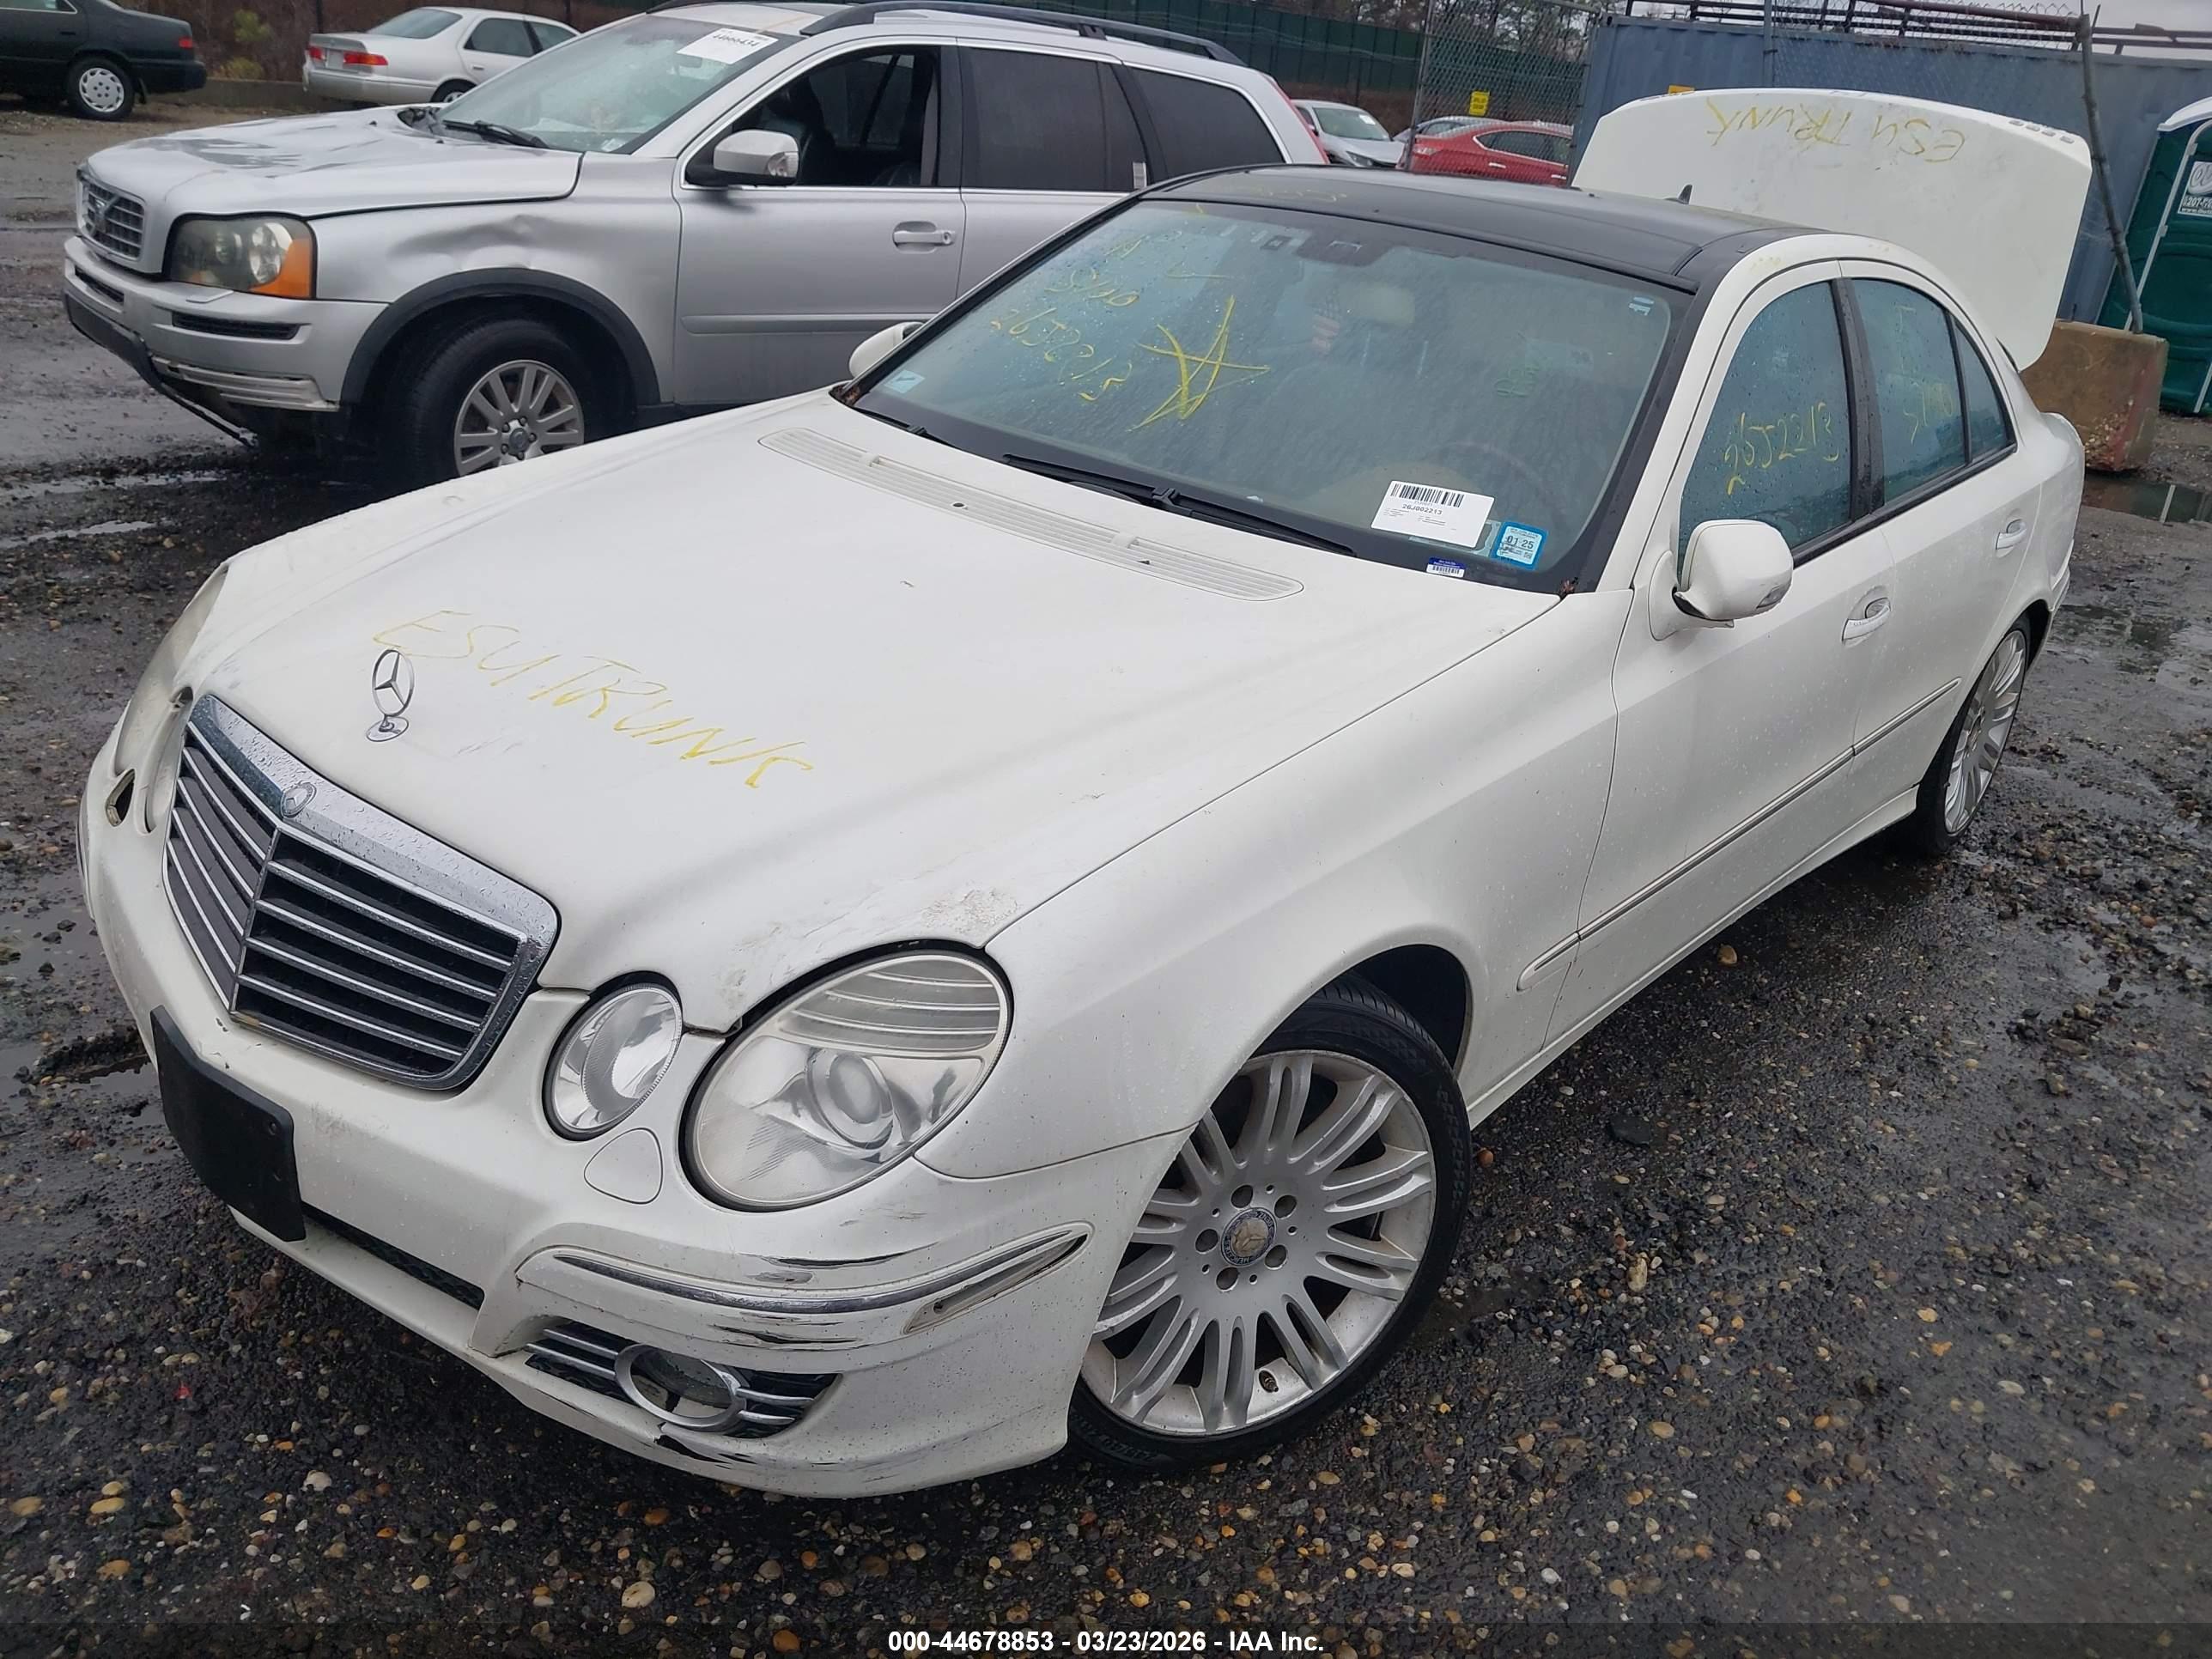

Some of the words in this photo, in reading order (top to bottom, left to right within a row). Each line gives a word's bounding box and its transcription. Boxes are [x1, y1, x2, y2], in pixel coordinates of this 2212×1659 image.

[1506, 534, 1519, 547] 01
[1522, 538, 1534, 550] 25
[526, 654, 815, 789] TRUNK
